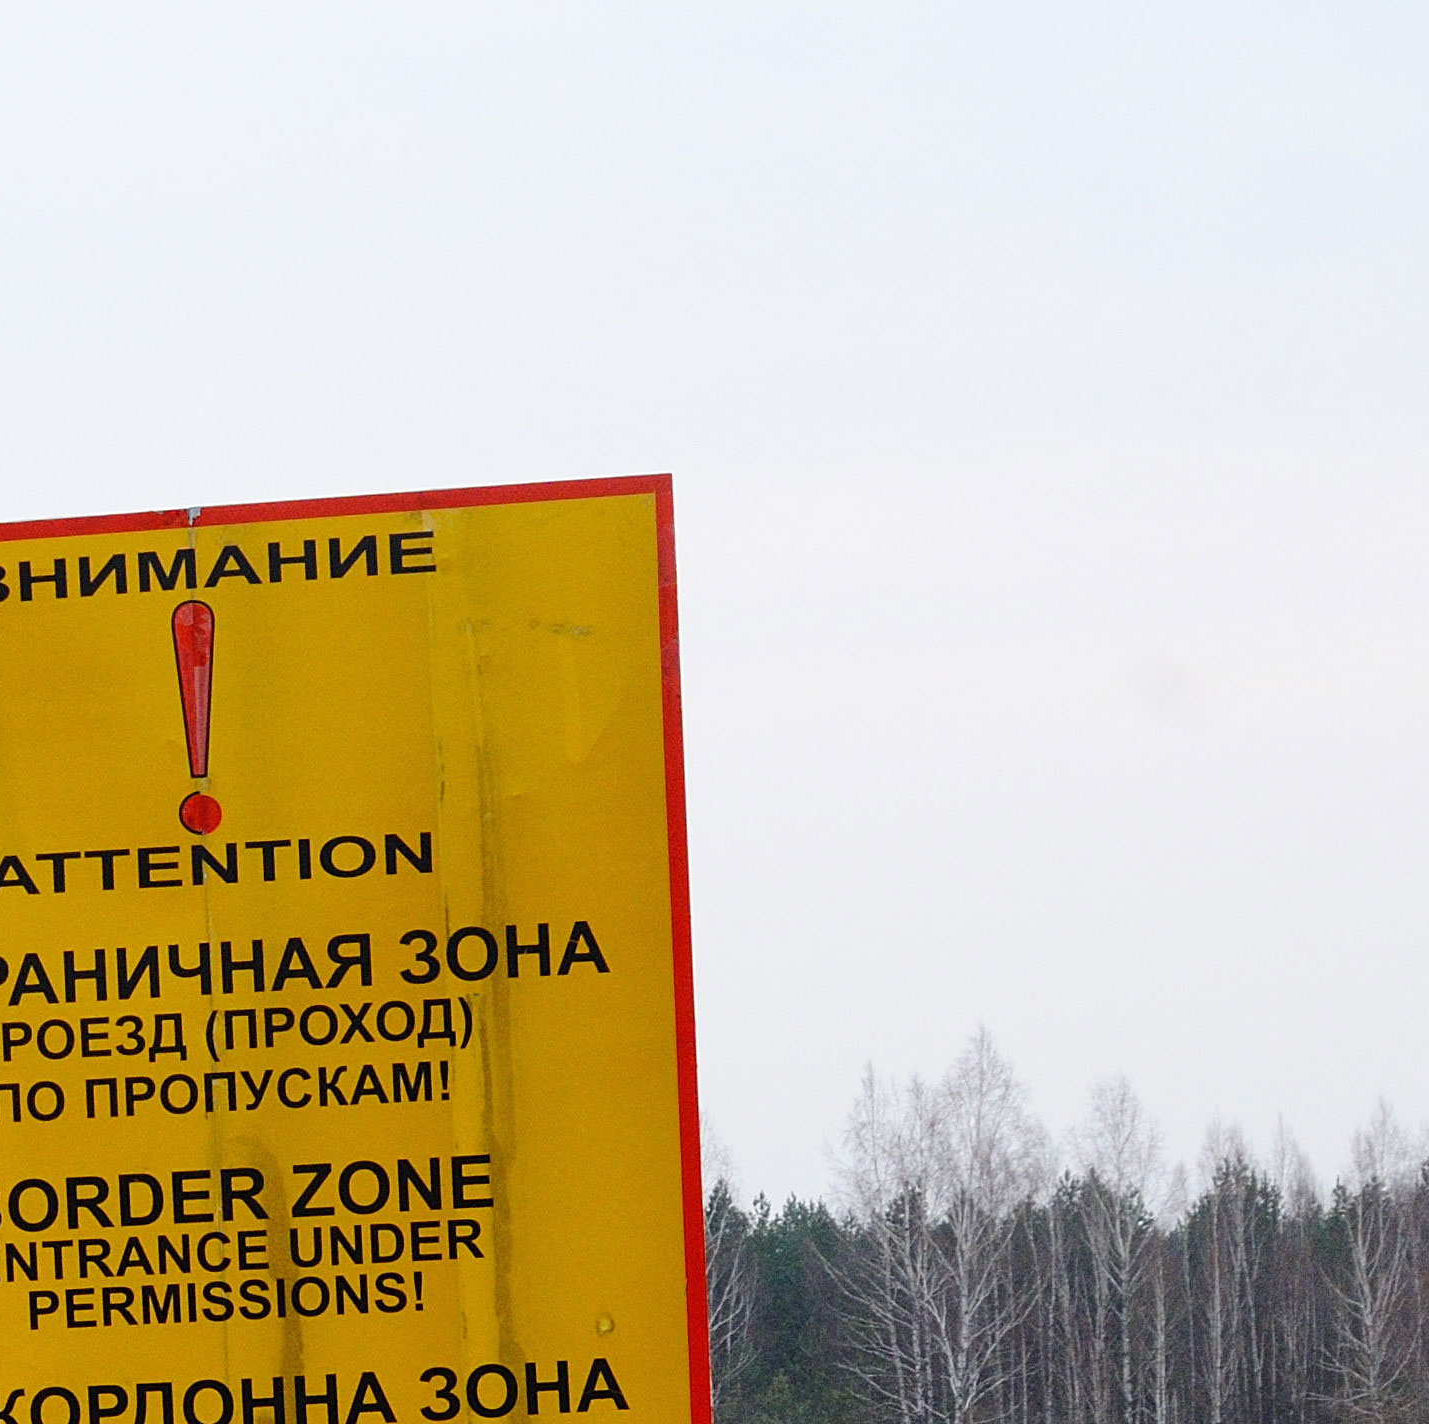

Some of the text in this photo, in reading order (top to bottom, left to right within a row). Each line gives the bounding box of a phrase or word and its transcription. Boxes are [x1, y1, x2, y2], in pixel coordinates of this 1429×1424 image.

[399, 920, 610, 985] ЗОНА
[205, 996, 473, 1063] (ПРОХОД)
[85, 1060, 450, 1119] ПРОПУСКАМ!
[291, 1153, 495, 1218] ZONE
[289, 1218, 485, 1268] UNDER
[28, 1271, 424, 1331] PERMISSIONS!
[419, 1357, 630, 1422] ЗОНА
